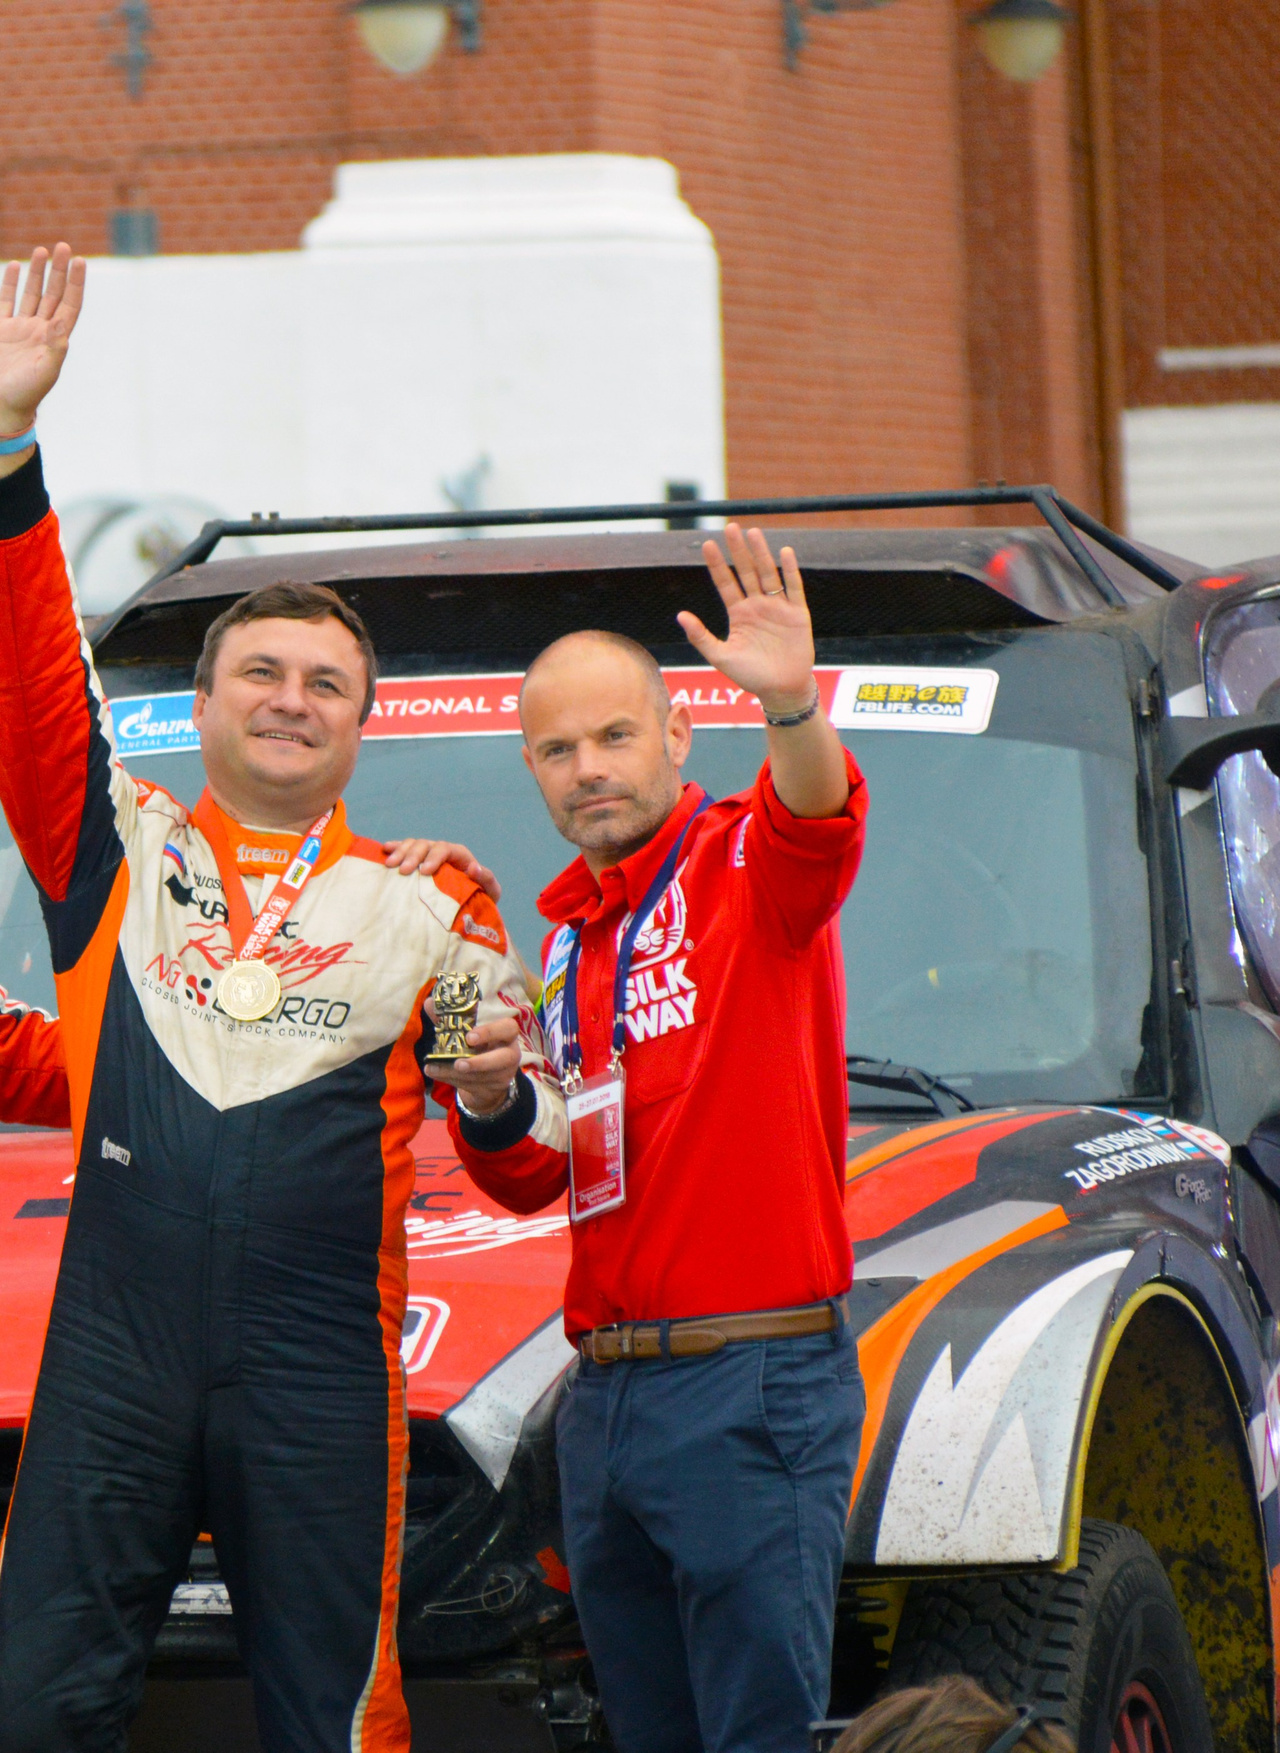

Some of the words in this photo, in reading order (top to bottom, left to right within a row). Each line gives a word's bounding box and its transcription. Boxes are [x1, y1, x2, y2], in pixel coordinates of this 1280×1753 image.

[371, 696, 491, 717] ATIONAL
[671, 688, 745, 705] ALLY
[854, 701, 963, 716] FBLIFE.COM
[147, 719, 200, 737] GAZPR
[237, 844, 290, 864] freem
[253, 911, 270, 935] WAY
[248, 935, 269, 960] RALL
[625, 957, 697, 1012] SILK
[141, 976, 180, 1005] CLOSED
[278, 1028, 348, 1045] COMPANY
[625, 989, 698, 1043] WAY
[434, 1014, 475, 1033] SILK
[1065, 1143, 1193, 1189] ZAGORODNIUK
